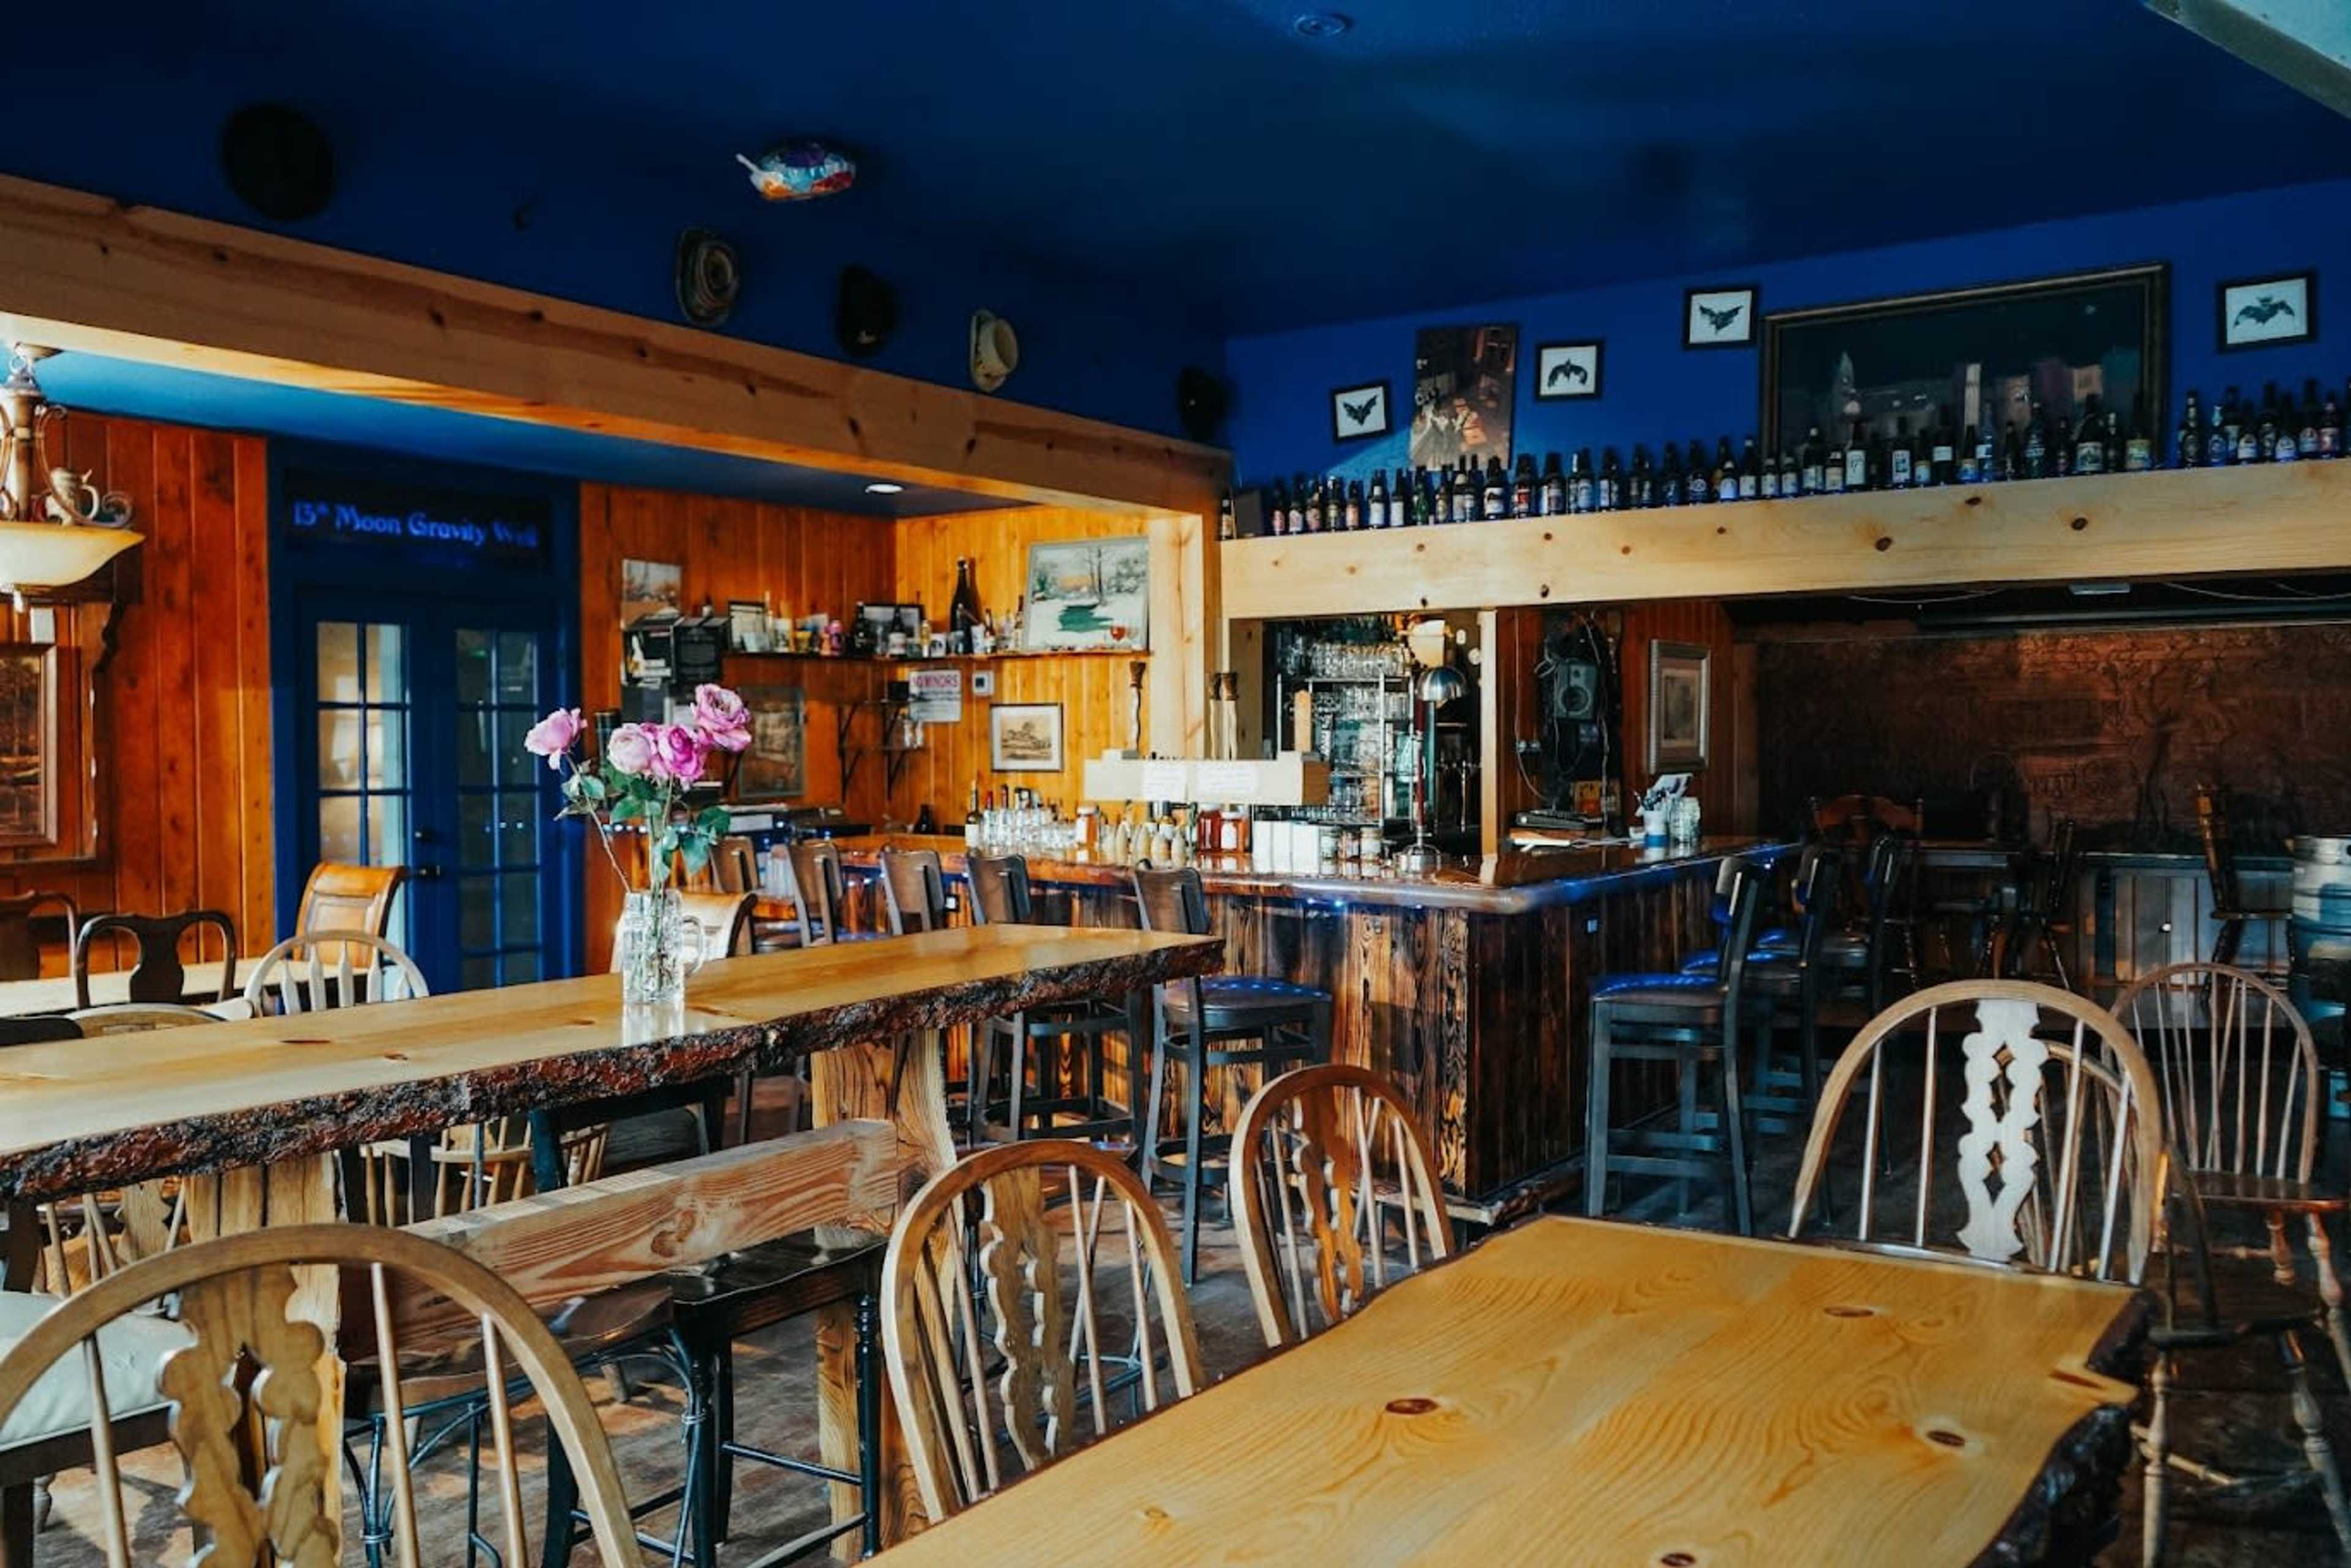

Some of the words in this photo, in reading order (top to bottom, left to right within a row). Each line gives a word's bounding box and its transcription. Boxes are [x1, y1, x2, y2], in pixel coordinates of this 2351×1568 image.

[335, 504, 402, 535] Moon
[408, 511, 486, 547] Gravity
[923, 674, 958, 688] MINORS
